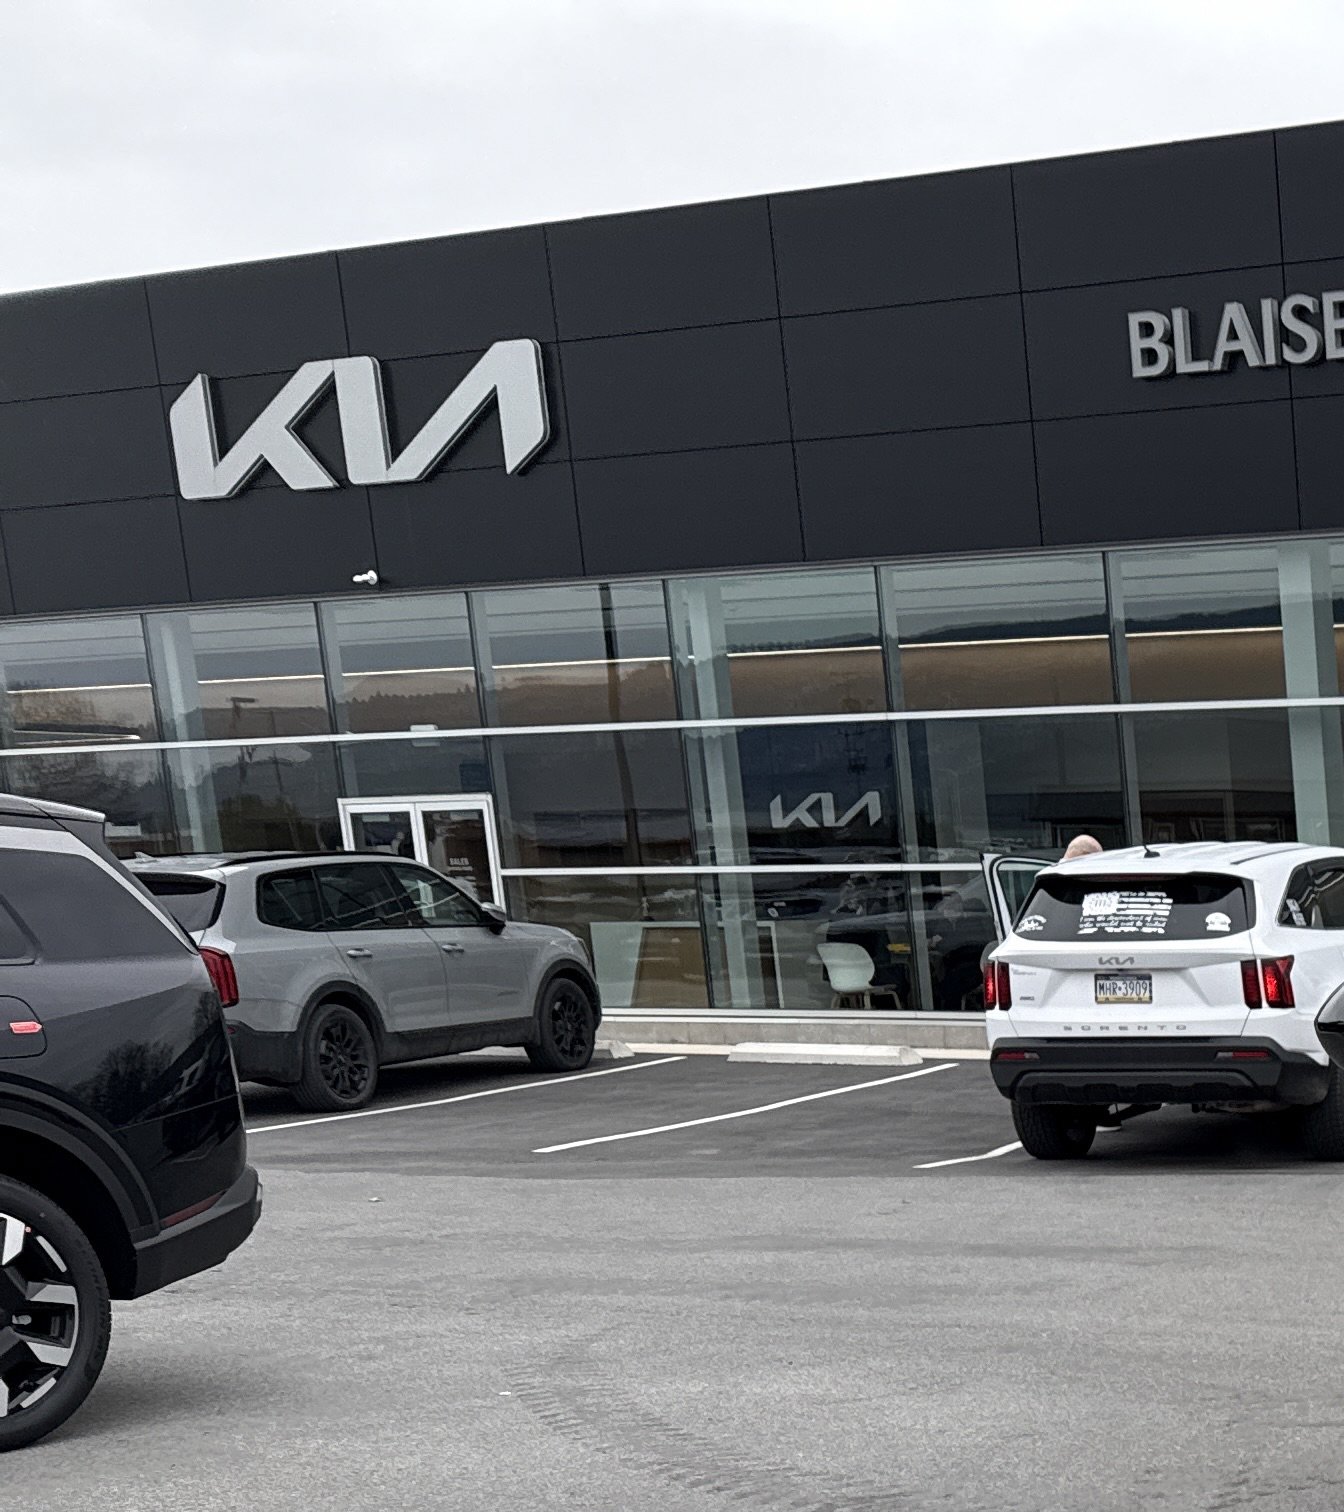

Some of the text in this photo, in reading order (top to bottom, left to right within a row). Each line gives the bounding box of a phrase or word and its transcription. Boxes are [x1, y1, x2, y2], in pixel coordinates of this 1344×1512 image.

[169, 338, 551, 500] KIA
[769, 790, 882, 829] KIA
[1098, 956, 1135, 966] KIA
[1098, 980, 1148, 997] MHR 3909
